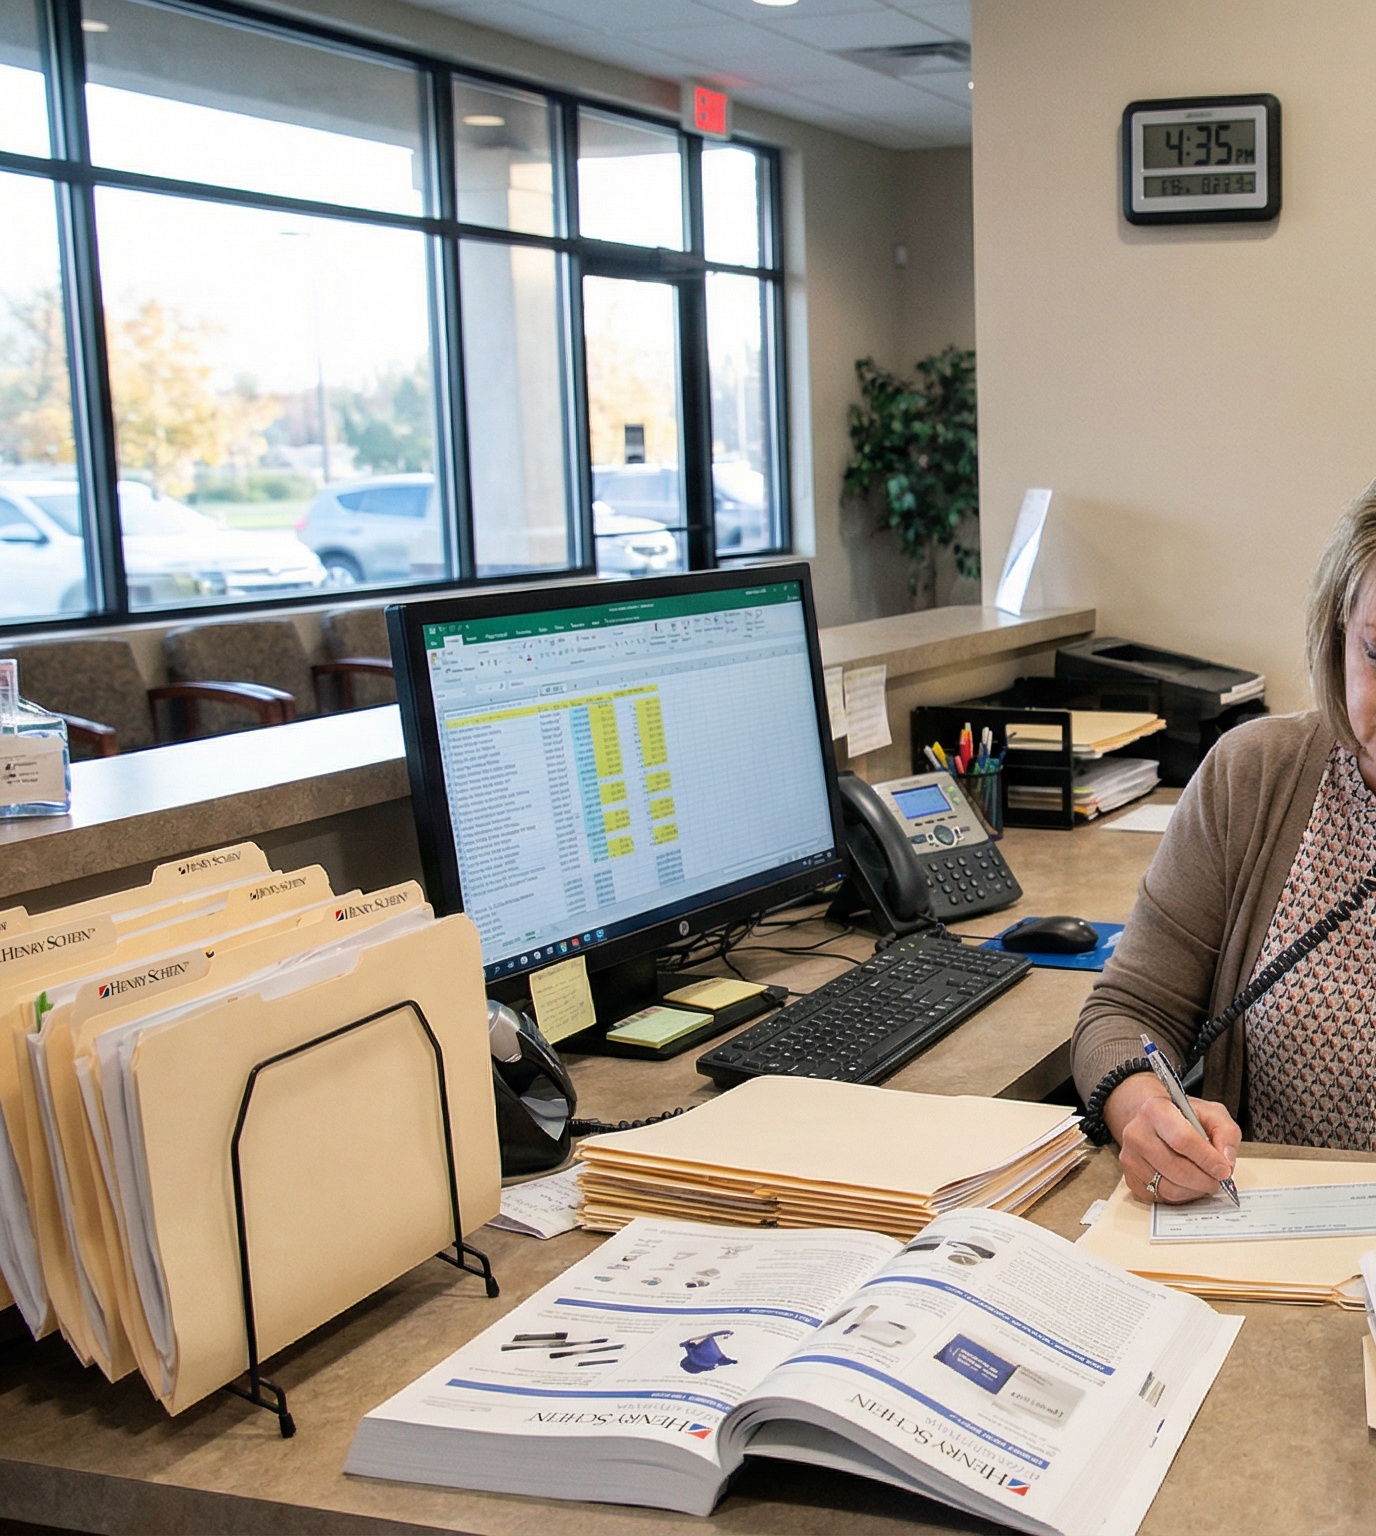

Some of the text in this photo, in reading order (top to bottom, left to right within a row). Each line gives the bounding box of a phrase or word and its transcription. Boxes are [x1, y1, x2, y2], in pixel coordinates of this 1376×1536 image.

[1165, 124, 1255, 165] 4:35 PM
[529, 1412, 613, 1426] SCHEIN
[611, 1413, 691, 1432] HENRY
[850, 1393, 934, 1445] SCHEIN
[931, 1440, 1008, 1486] HENRY
